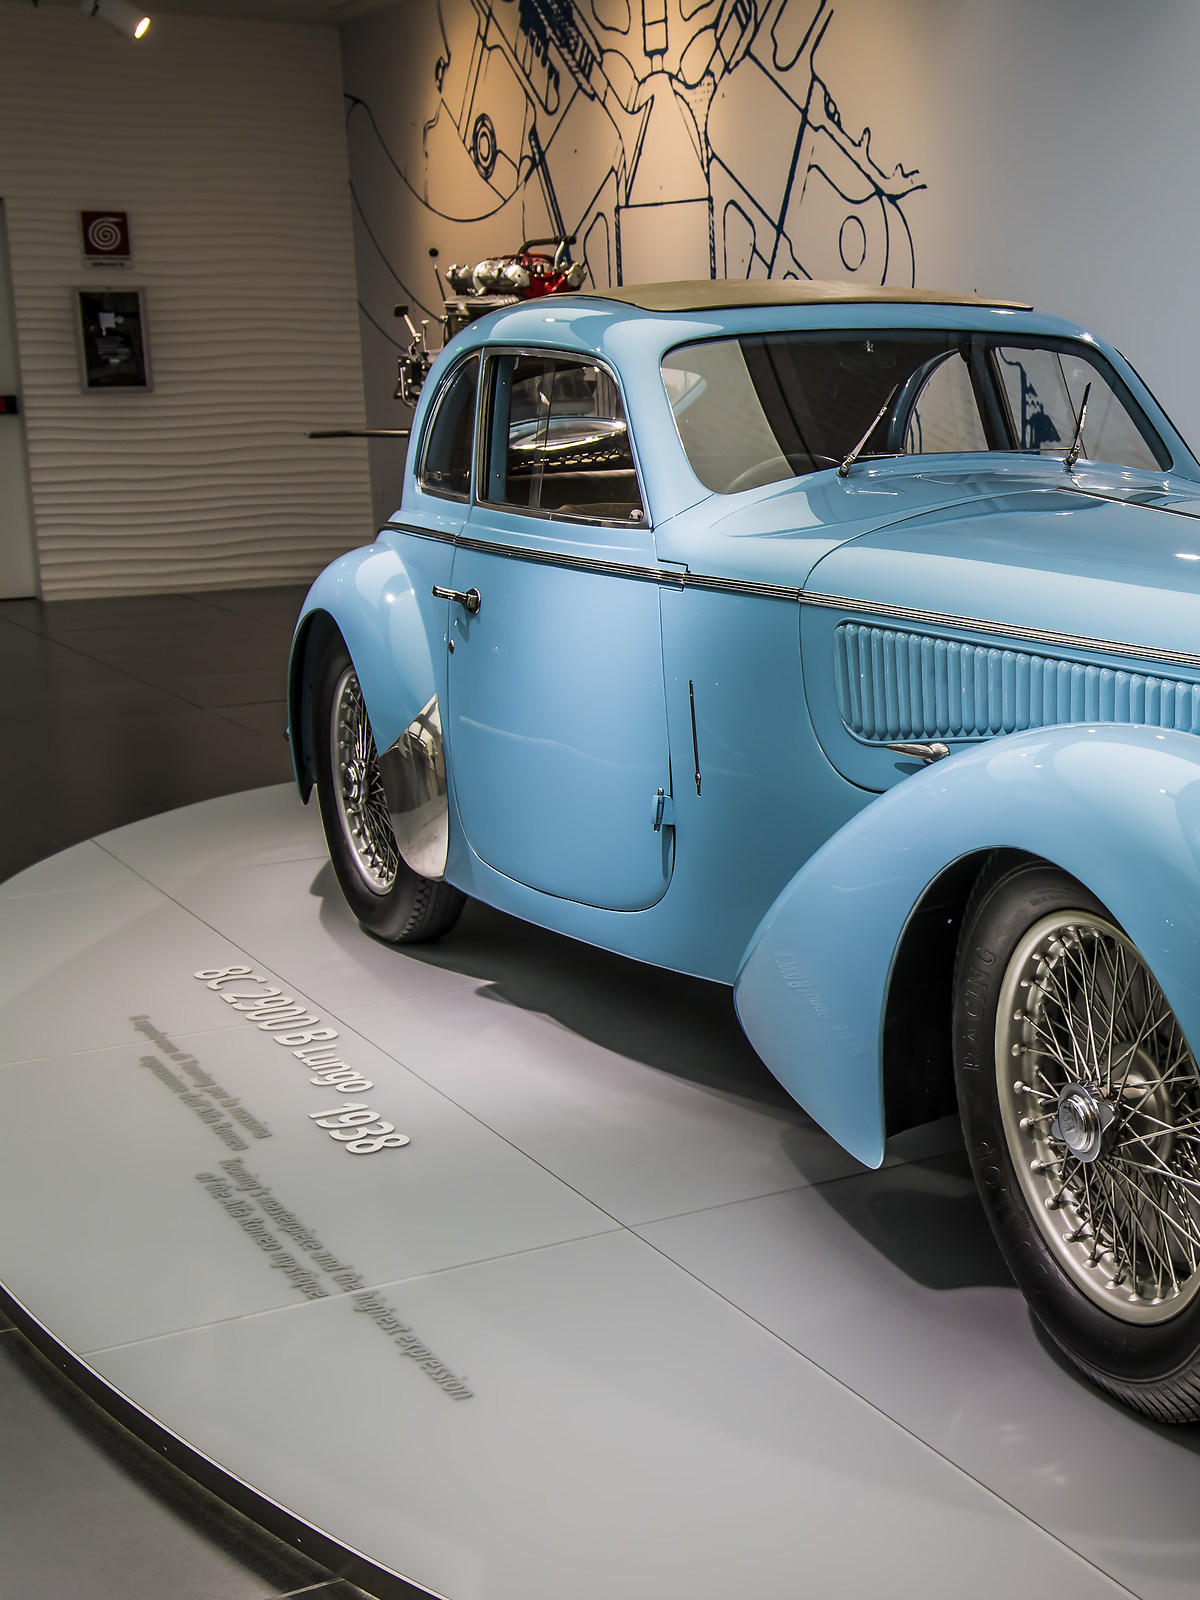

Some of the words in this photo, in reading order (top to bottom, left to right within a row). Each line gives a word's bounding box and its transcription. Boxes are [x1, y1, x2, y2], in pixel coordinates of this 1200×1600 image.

[194, 965, 267, 991] 8C
[219, 986, 321, 1031] 2900
[962, 946, 996, 1073] RACING
[273, 1027, 339, 1046] B
[292, 1044, 374, 1093] Lungo
[210, 1121, 249, 1151] Romeo
[308, 1102, 411, 1154] 1938
[194, 1172, 227, 1183] of
[204, 1183, 233, 1199] the
[219, 1199, 256, 1218] Alfa
[238, 1217, 283, 1251] Romeo
[218, 1156, 271, 1197] Touring's
[255, 1196, 323, 1251] masterpiece
[310, 1251, 353, 1272] and
[332, 1272, 364, 1292] the
[351, 1290, 411, 1335] highest
[395, 1335, 475, 1400] expression
[269, 1252, 330, 1300] mystique
